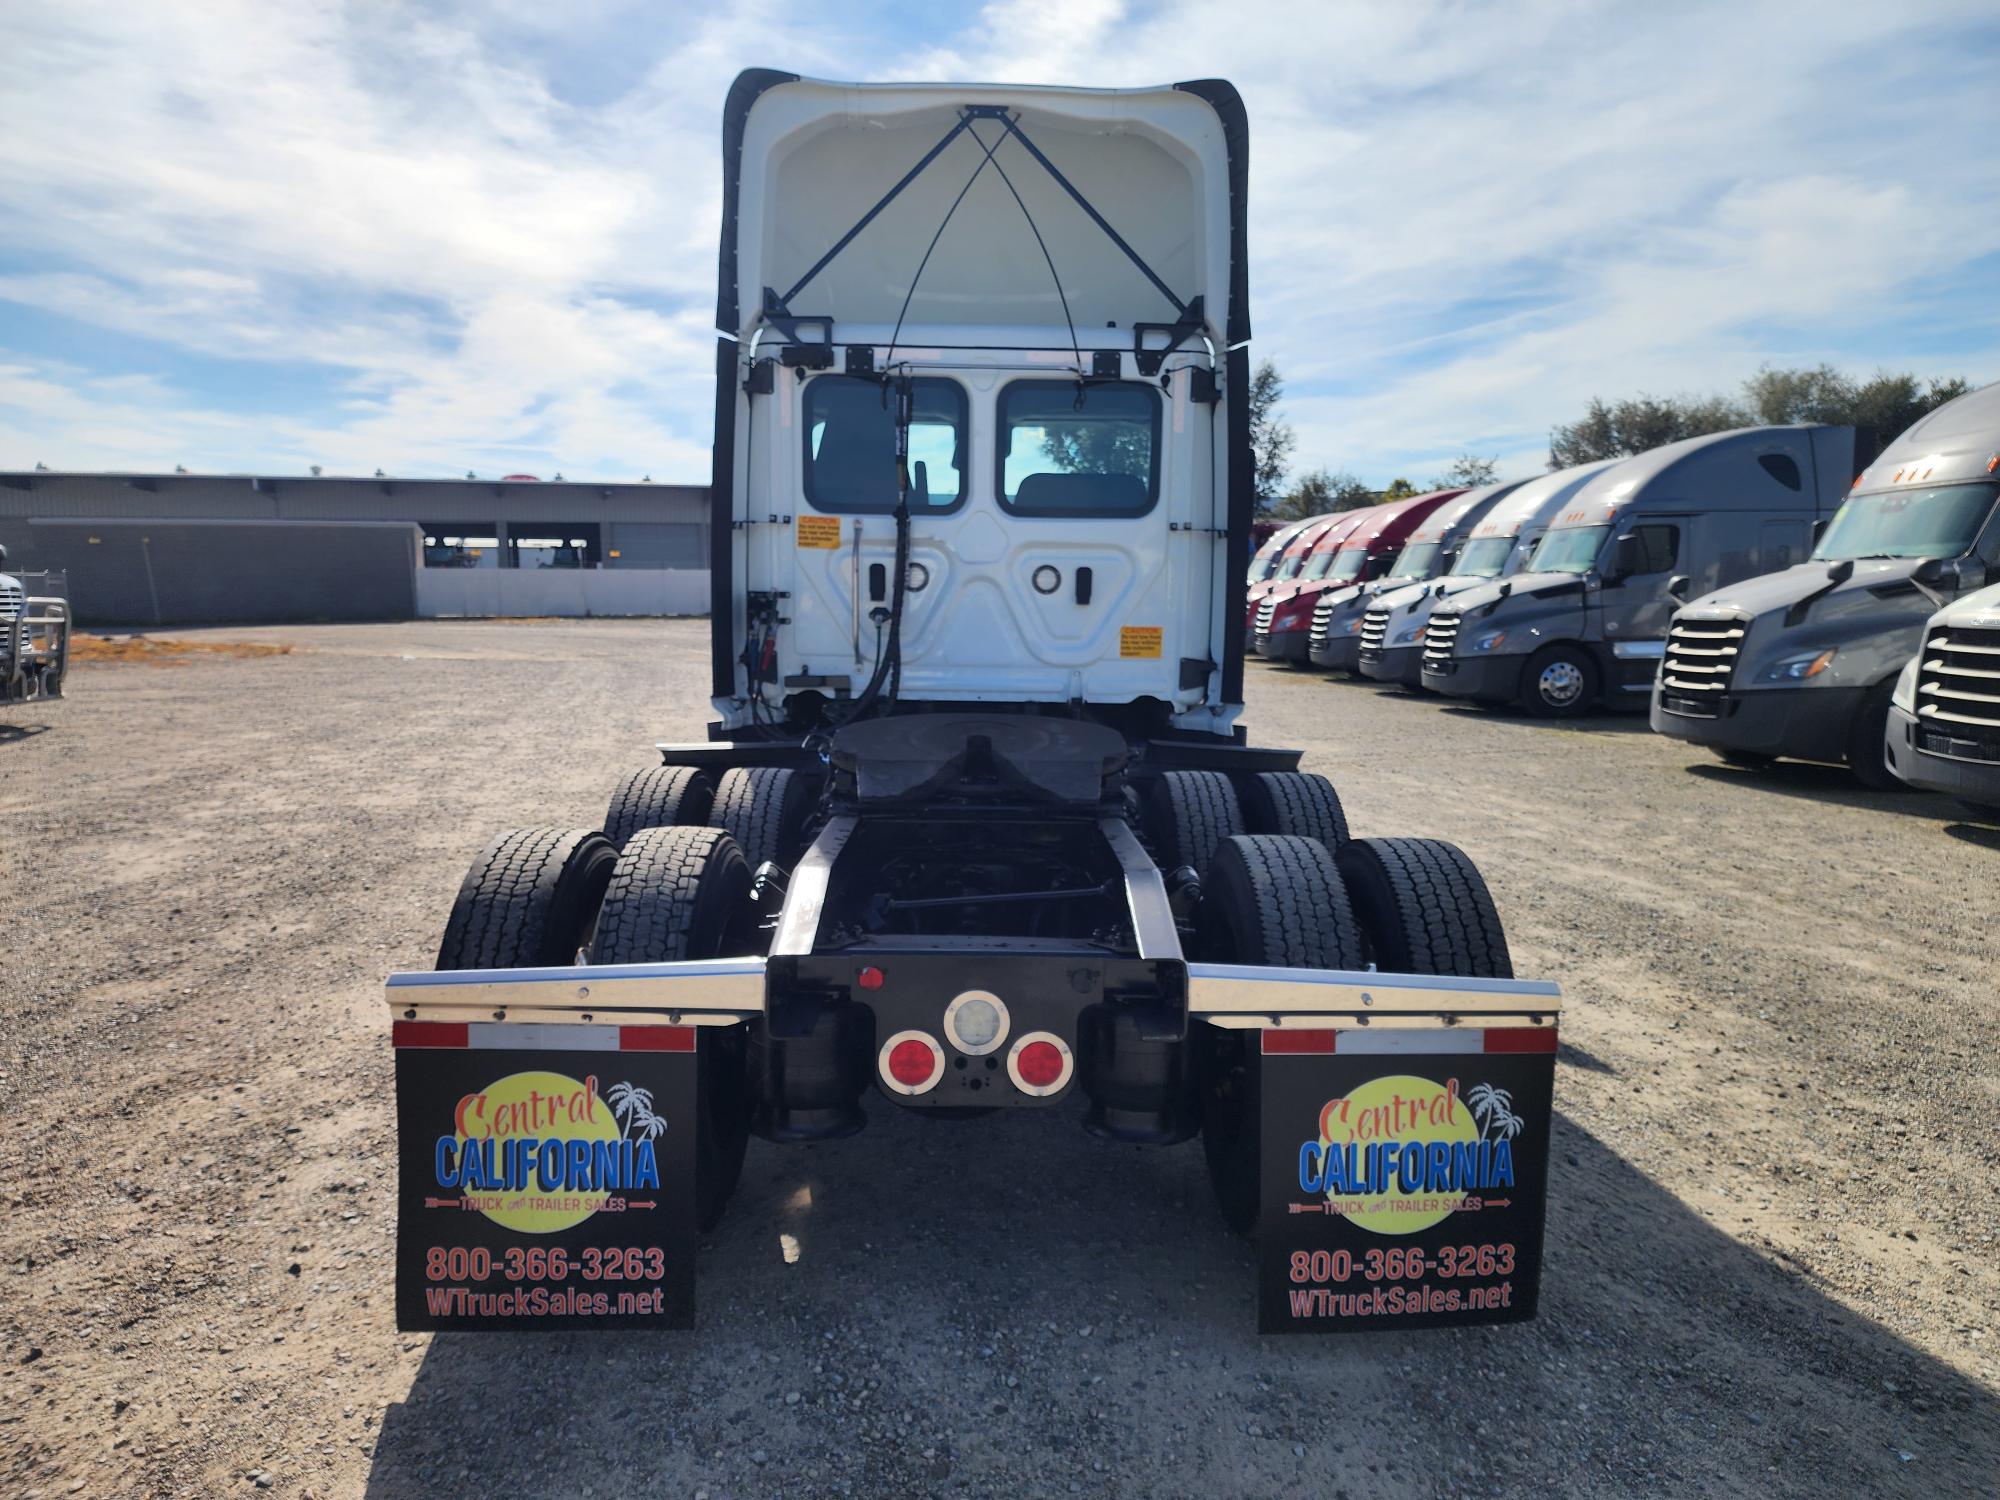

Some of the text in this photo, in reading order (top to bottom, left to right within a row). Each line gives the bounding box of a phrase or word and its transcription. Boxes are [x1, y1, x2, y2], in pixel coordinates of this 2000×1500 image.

[453, 1075, 599, 1143] Central
[1319, 1077, 1459, 1146] Central
[435, 1135, 660, 1192] CALIFORNIA
[1299, 1140, 1515, 1195] CALIFORNIA
[460, 1197, 503, 1211] TRUCK
[529, 1197, 581, 1211] TRAILER
[584, 1197, 626, 1212] SALES
[1323, 1200, 1364, 1216] TRUCK
[1389, 1199, 1440, 1212] TRAILER
[1443, 1196, 1482, 1211] SALES
[426, 1247, 665, 1281] 800-366-3263
[1289, 1243, 1516, 1283] 800-366-3263
[426, 1287, 665, 1317] WTruckSales.net
[1289, 1282, 1513, 1318] WTruckSales.net
